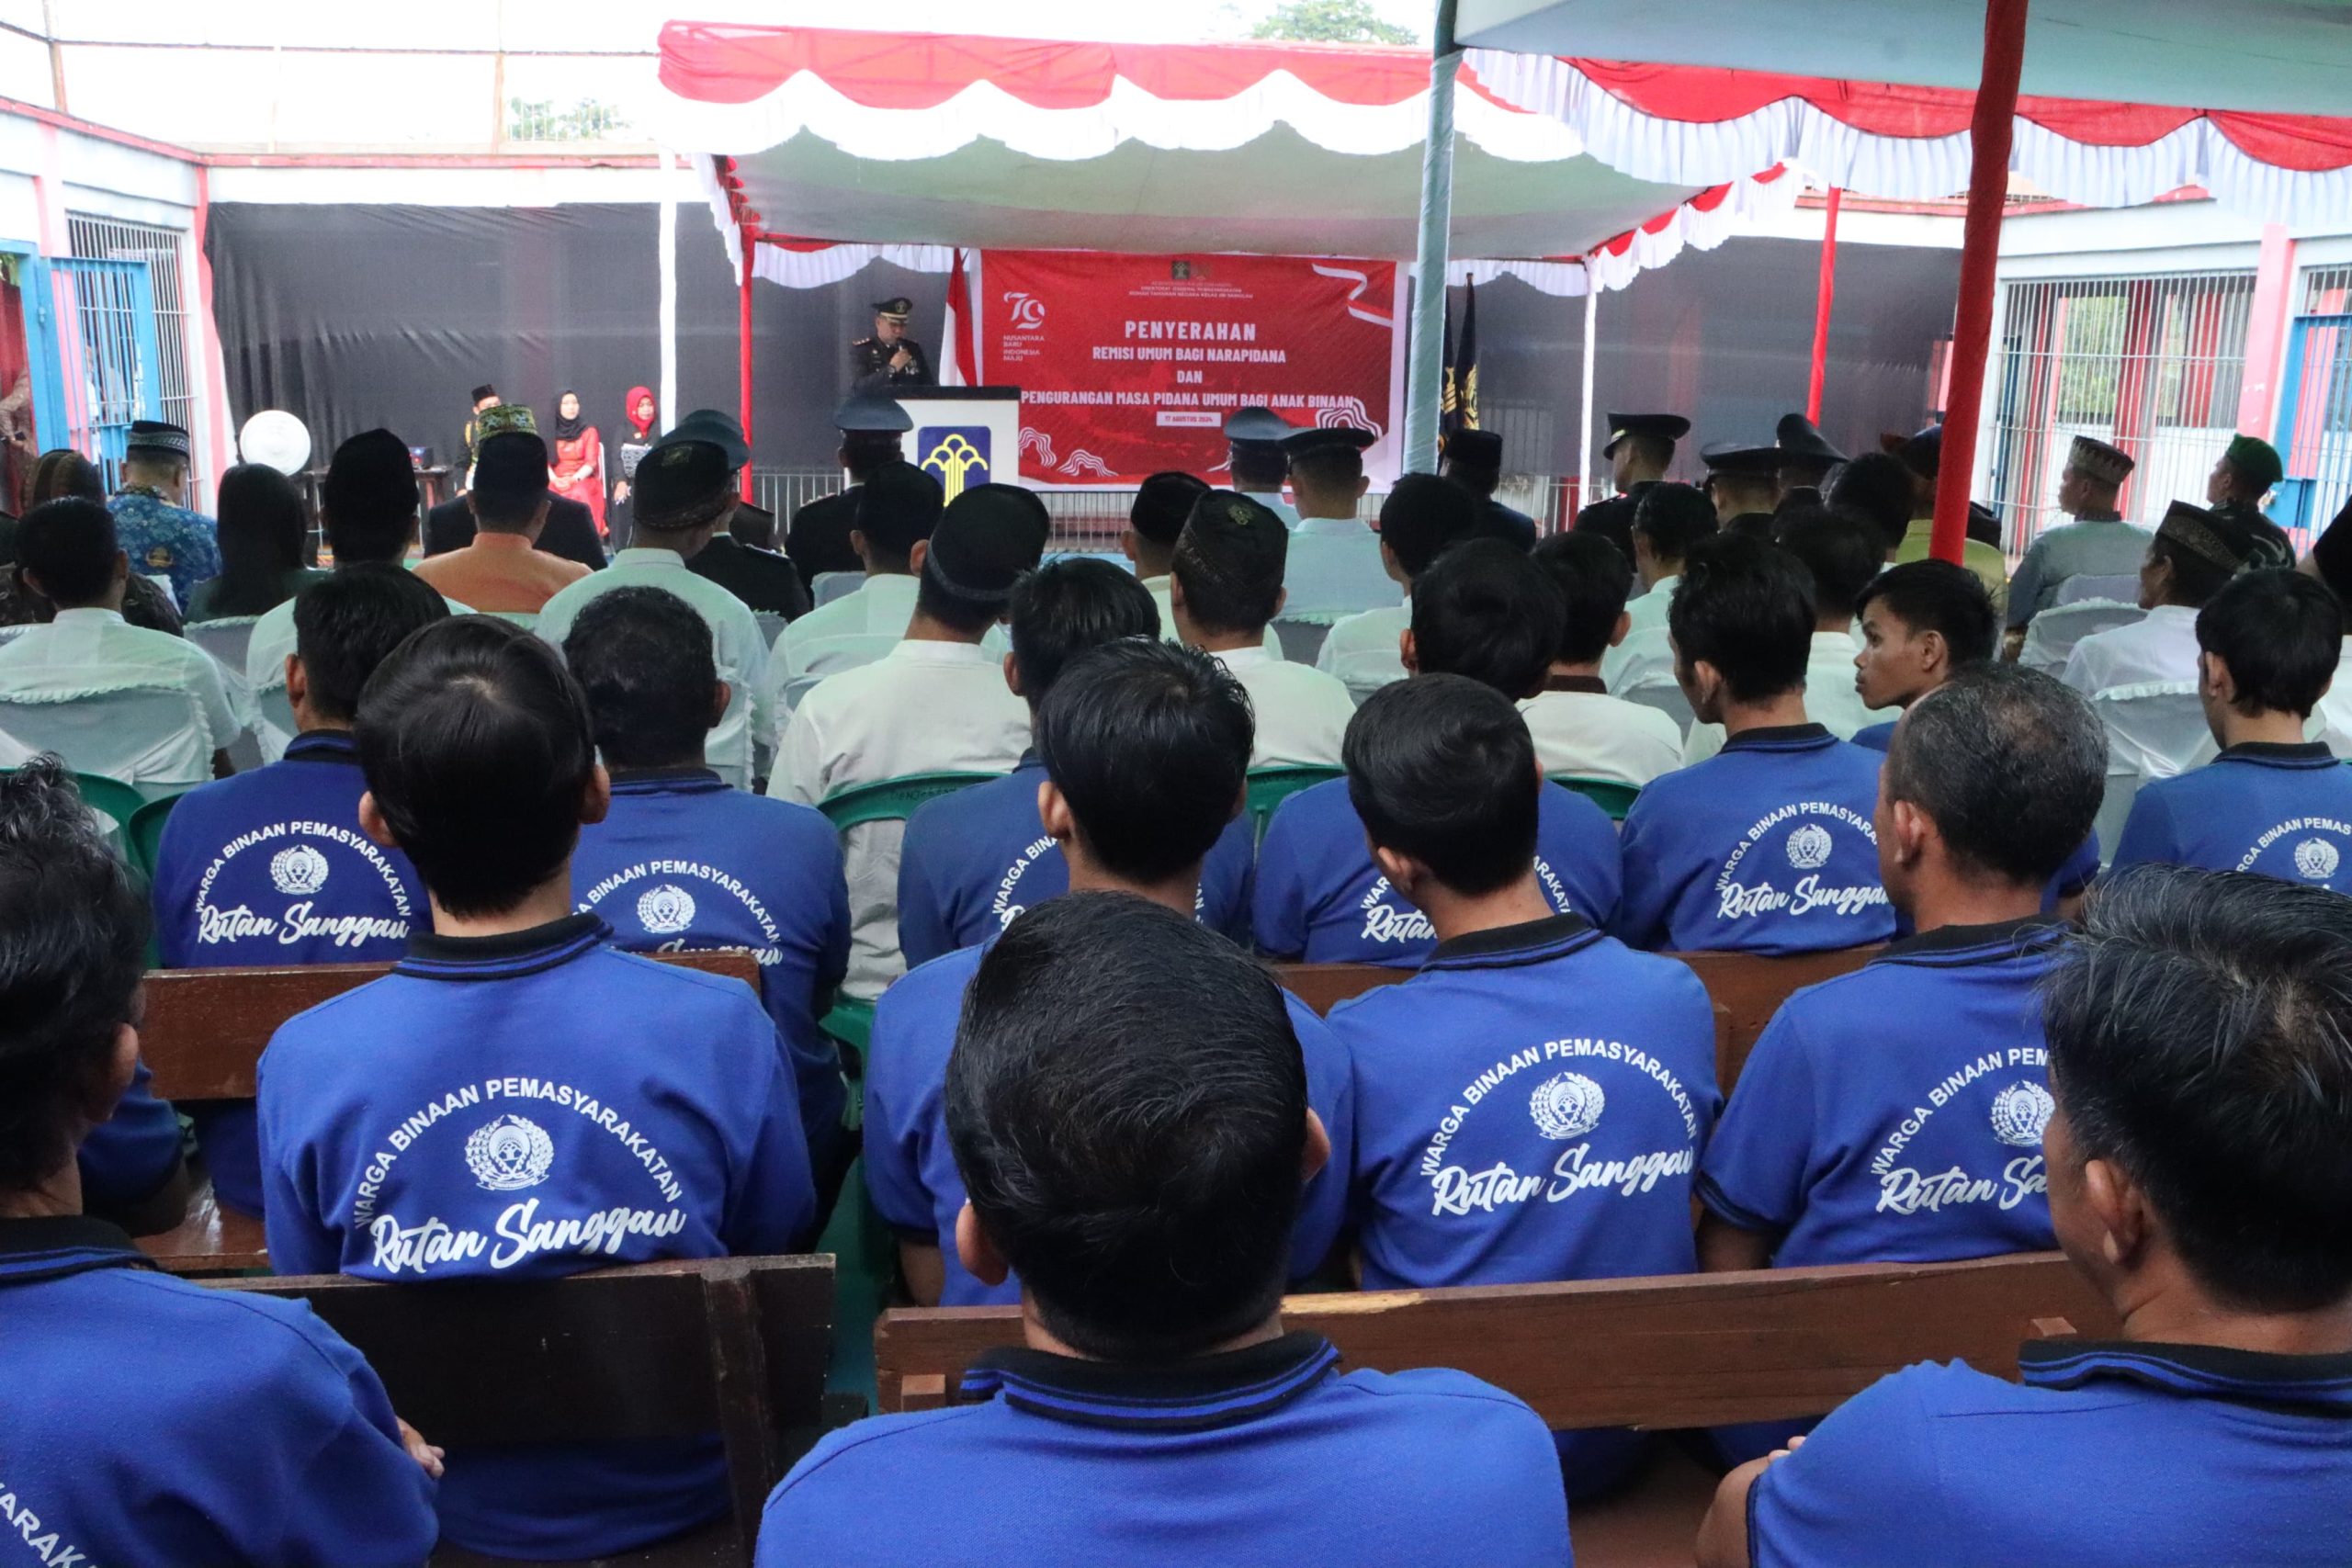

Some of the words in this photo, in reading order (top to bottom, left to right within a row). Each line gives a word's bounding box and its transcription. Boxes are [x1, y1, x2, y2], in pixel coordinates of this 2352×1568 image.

[1092, 346, 1134, 360] REMISI
[1137, 347, 1172, 360] UMUM
[1175, 347, 1204, 361] BAGI
[1207, 348, 1286, 363] NARAPIDANA
[1125, 321, 1256, 341] PENYERAHAN
[1021, 390, 1113, 405] PENGURANGAN
[1116, 391, 1149, 405] MASA
[1153, 392, 1199, 406] PIDANA
[1202, 393, 1238, 407] UMUM
[1240, 394, 1268, 408] BAGI
[1271, 394, 1305, 408] ANAK
[1307, 395, 1353, 408] BINAAN
[1177, 370, 1203, 384] DAN
[1714, 840, 1752, 891] WARGA
[1747, 804, 1798, 841] BINAAN
[1801, 802, 1878, 845] PEMASYARA
[2257, 818, 2301, 849] BINAAN
[195, 859, 225, 913] WARGA
[222, 823, 286, 859] BINAAN
[290, 821, 412, 917] PEMASYARAKATAN
[992, 858, 1030, 914] WARGA
[198, 904, 277, 943] Rutan
[278, 900, 411, 947] Sanggau
[587, 863, 647, 905] BINAAN
[650, 860, 781, 943] PEMASYARAKATAN
[1717, 882, 1791, 919] Rutan
[1420, 1104, 1470, 1177] WARGA
[1463, 1046, 1541, 1105] BINAAN
[1544, 1038, 1698, 1141] PEMASYARAKATAN
[1871, 1105, 1933, 1176] WARGA
[1928, 1051, 2003, 1107] BINAAN
[354, 1151, 397, 1229] WARGA
[388, 1084, 480, 1152] BINAAN
[485, 1077, 683, 1203] PEMASYARAKATAN
[1431, 1161, 1546, 1216] Rutan
[1546, 1143, 1694, 1203] Sanggau
[1875, 1166, 1998, 1215] Rutan
[369, 1213, 488, 1274] Rutan
[490, 1197, 687, 1269] Sanggau
